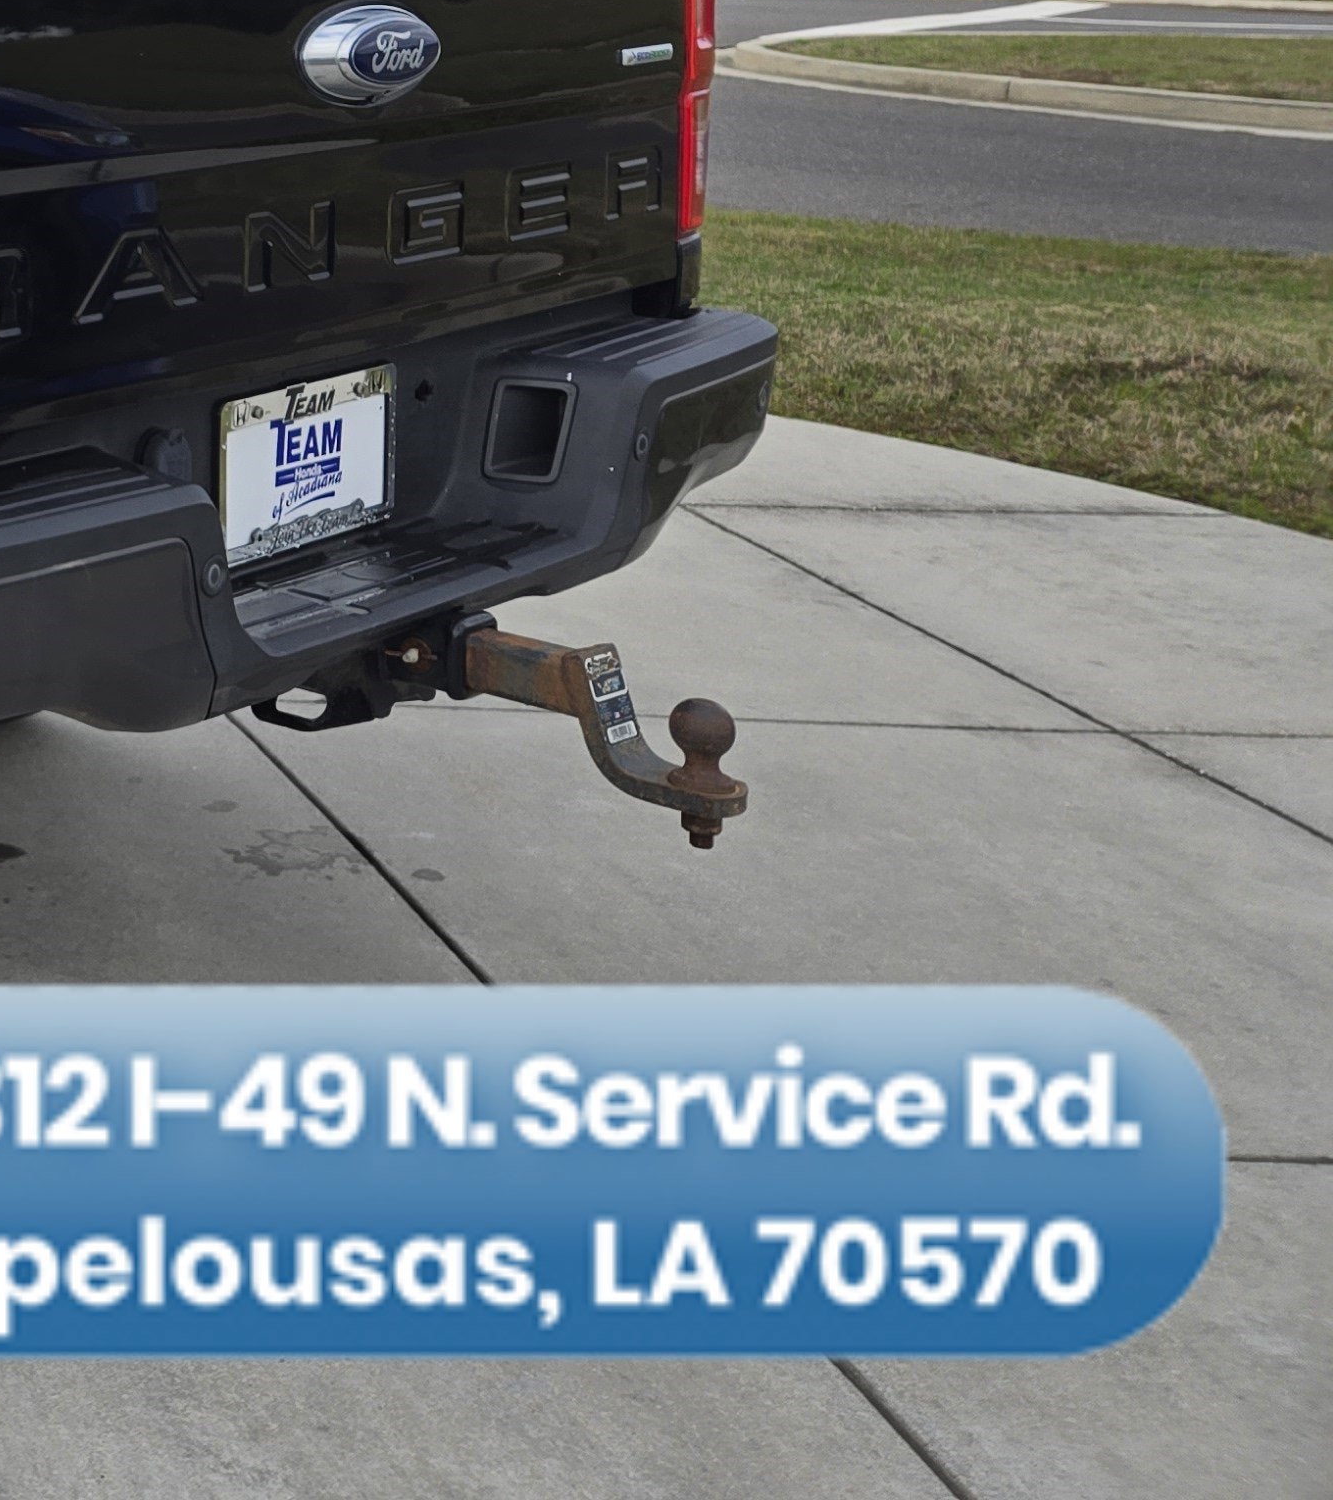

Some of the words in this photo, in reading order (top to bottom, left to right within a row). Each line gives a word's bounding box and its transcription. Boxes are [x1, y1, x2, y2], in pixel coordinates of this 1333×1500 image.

[371, 30, 426, 74] Ford
[284, 385, 336, 422] TEAM
[269, 418, 343, 468] TEAM
[272, 491, 285, 524] of
[286, 471, 343, 507] Acadiana
